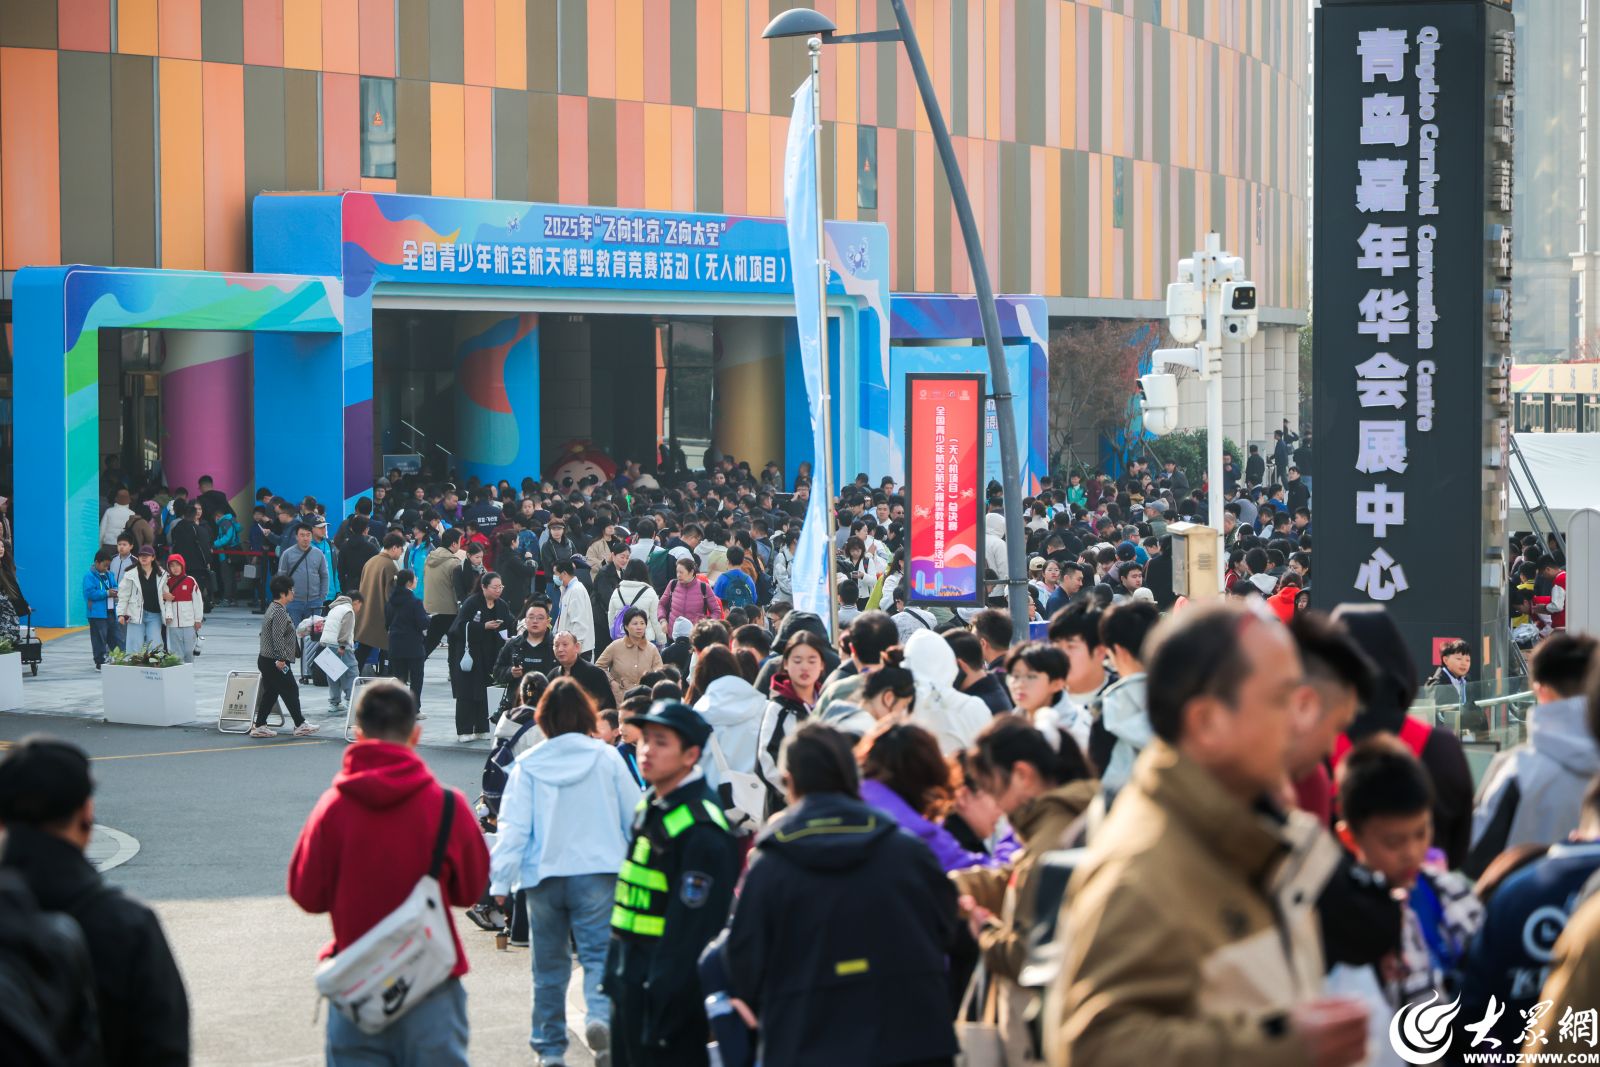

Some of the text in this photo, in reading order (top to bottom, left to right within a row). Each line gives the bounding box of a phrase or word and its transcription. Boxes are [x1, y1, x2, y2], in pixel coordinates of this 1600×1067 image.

[402, 239, 788, 284] 全国青少年航空航天模型教育竞赛活动（无人机项目）
[1354, 27, 1410, 601] 青岛嘉年华会展中心
[1415, 26, 1440, 432] Qingdao Carnival Convention Centre
